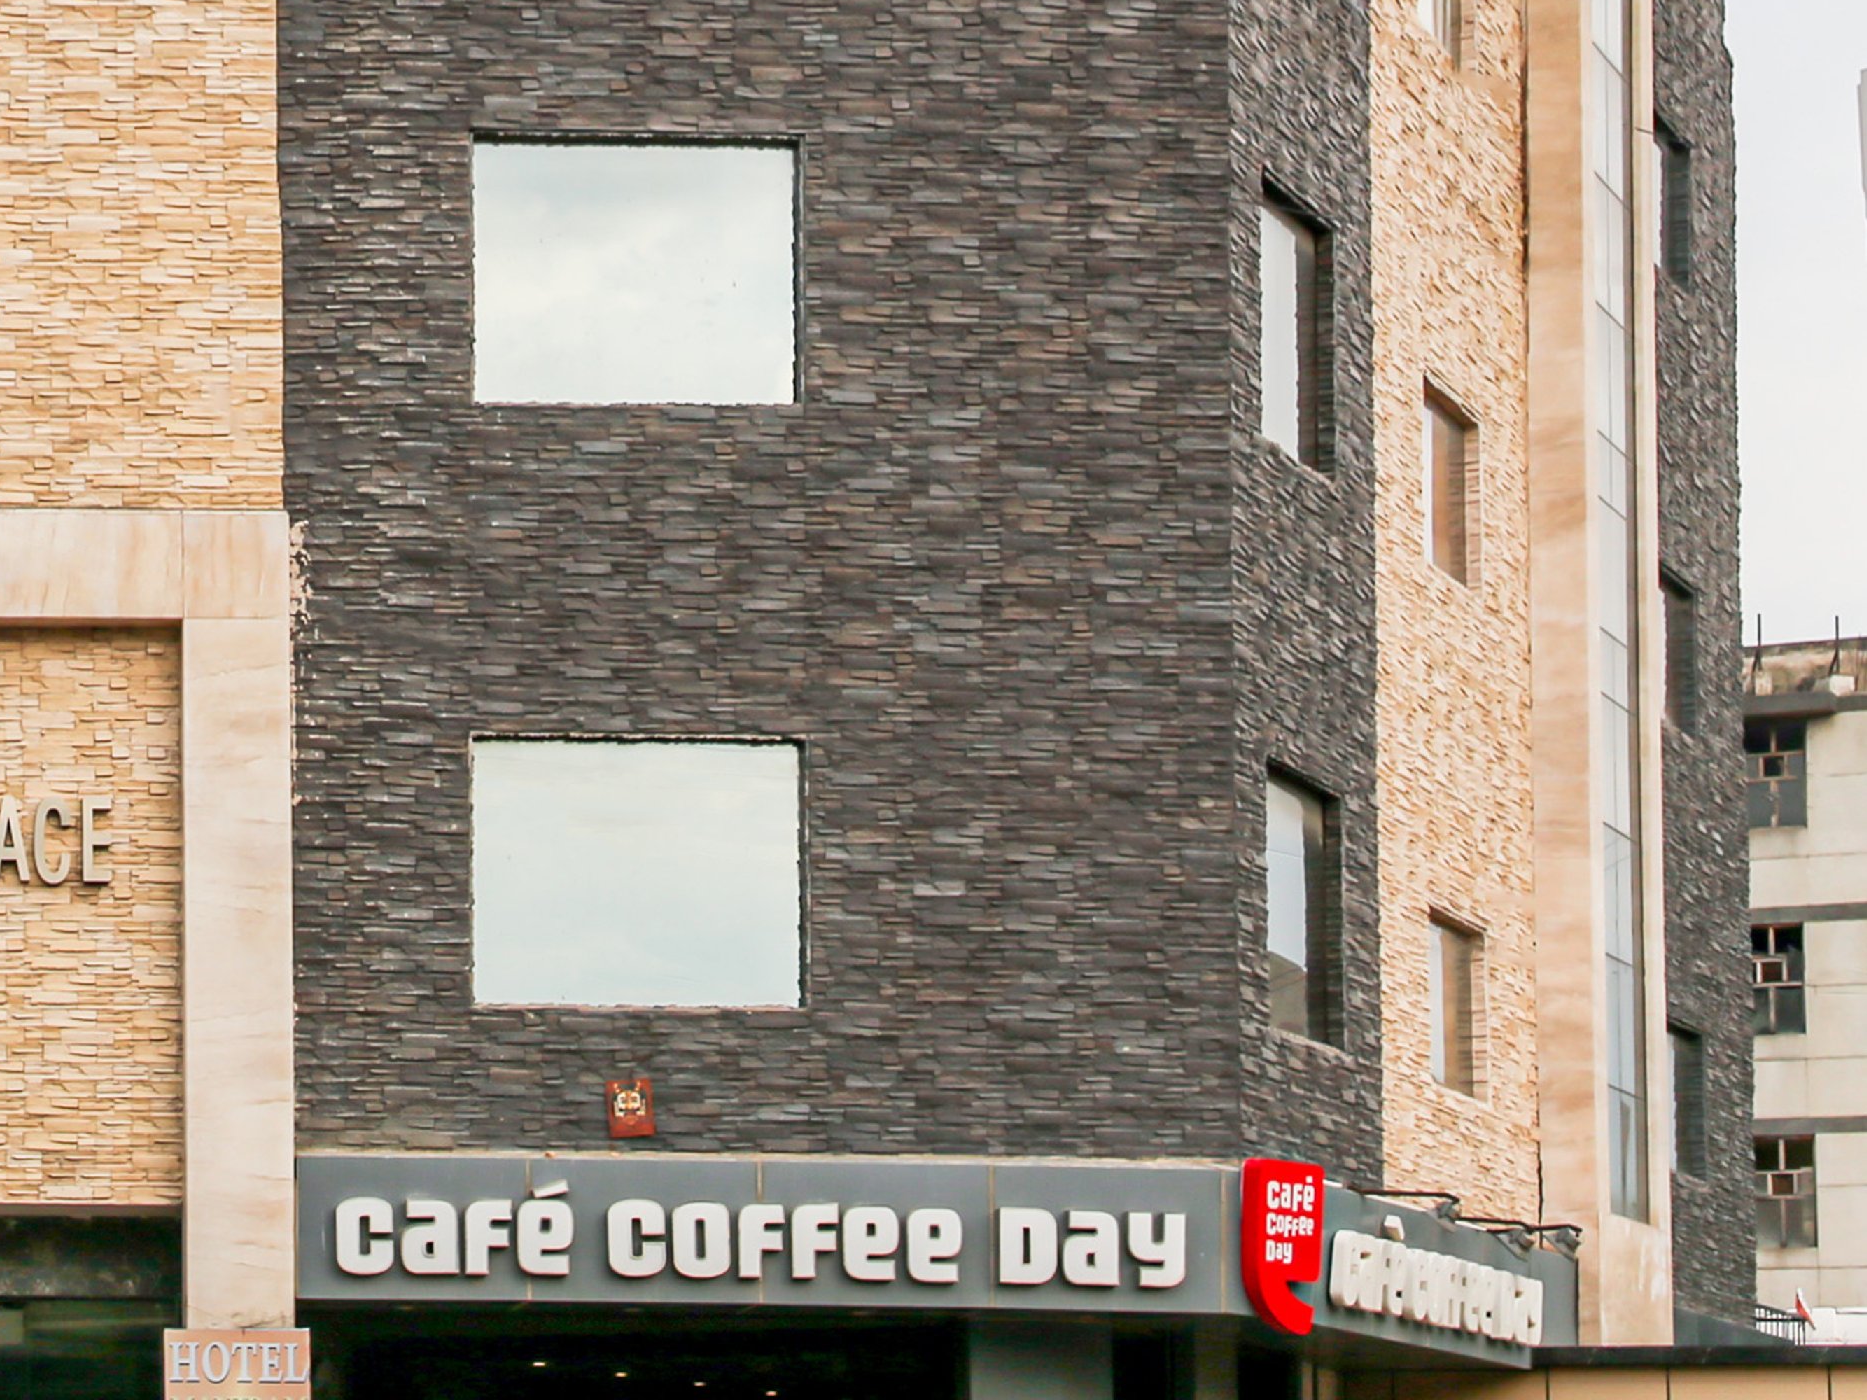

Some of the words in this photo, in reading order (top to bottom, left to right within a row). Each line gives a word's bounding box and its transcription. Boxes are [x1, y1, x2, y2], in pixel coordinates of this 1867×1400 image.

[1265, 1212, 1315, 1238] Coffee
[1265, 1239, 1293, 1265] Day
[169, 1341, 310, 1384] HOTEL
